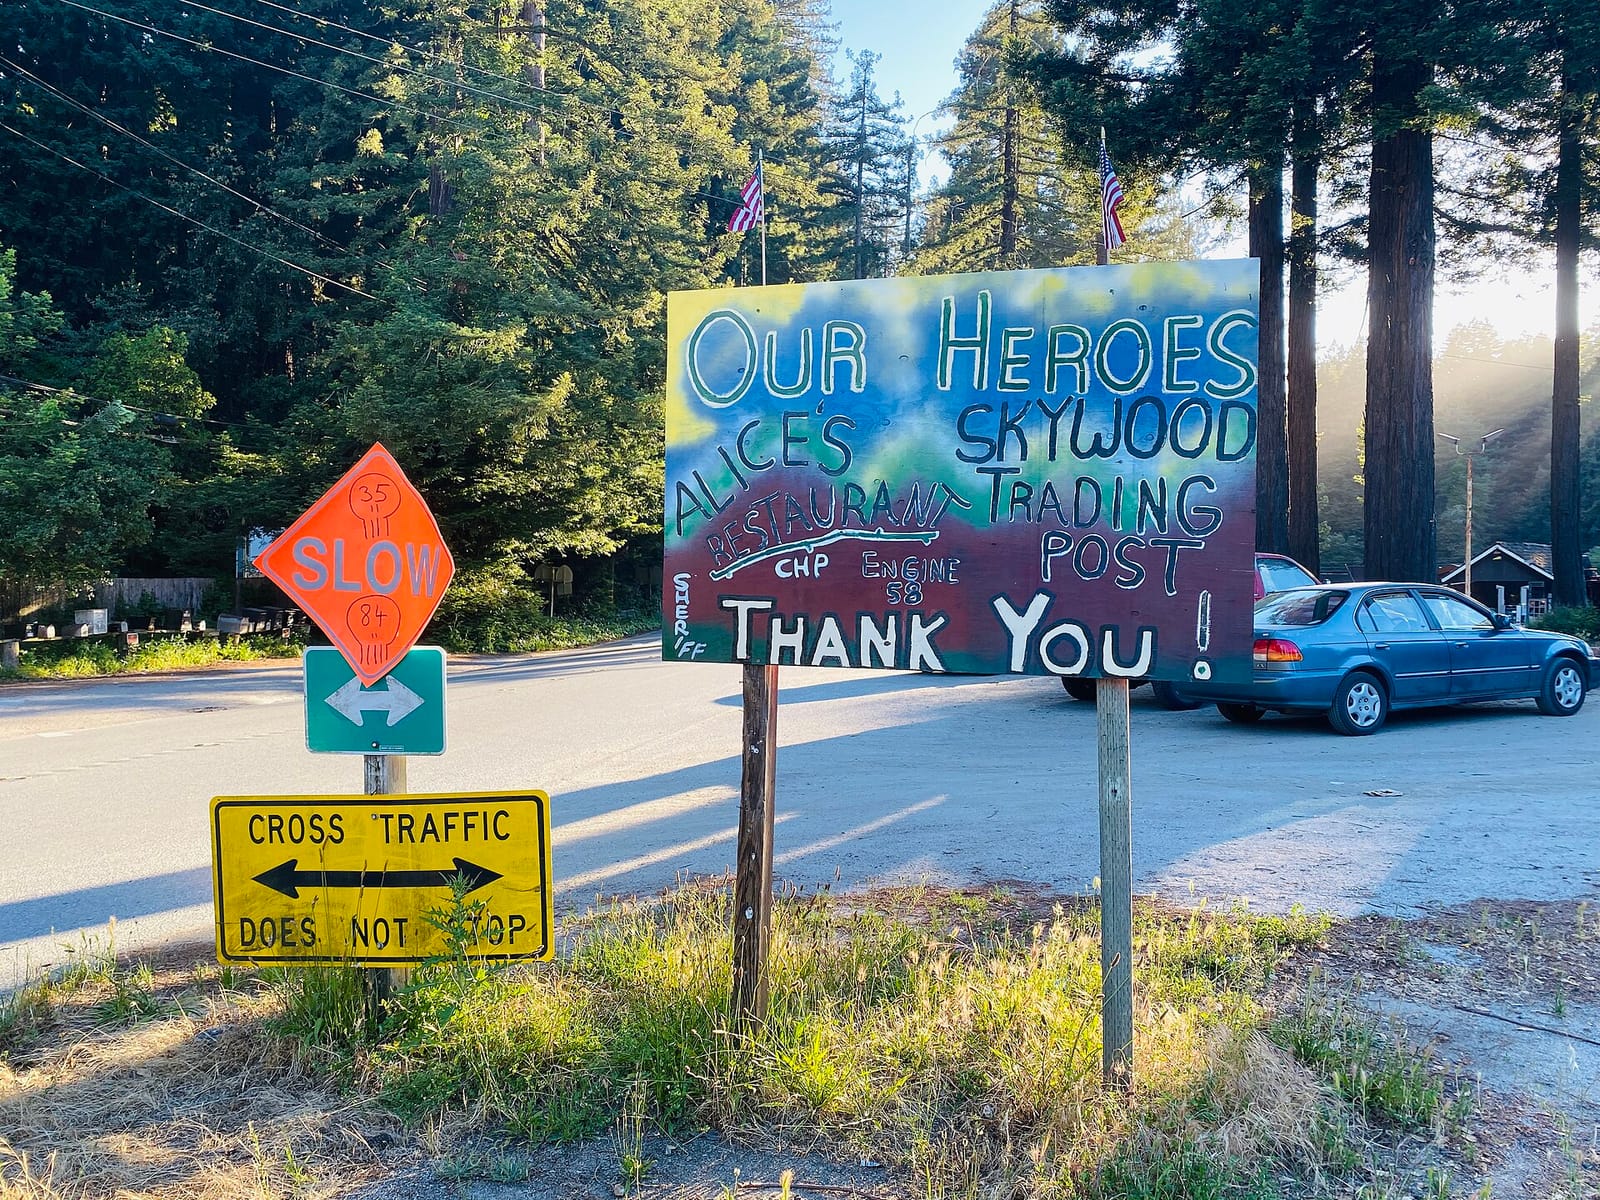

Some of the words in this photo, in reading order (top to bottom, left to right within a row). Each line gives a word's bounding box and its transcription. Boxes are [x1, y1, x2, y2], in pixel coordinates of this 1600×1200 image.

[687, 308, 866, 408] OUR
[937, 289, 1259, 399] HEROES
[956, 395, 1257, 464] SKYWOOD
[358, 484, 390, 503] 35
[675, 399, 856, 535] ALICE'S
[705, 479, 973, 567] RESTAURANT
[976, 467, 1224, 538] TRADING
[292, 536, 441, 599] SLOW
[774, 552, 830, 580] CHP
[861, 550, 961, 585] ENGINE
[886, 579, 924, 606] 58
[1041, 530, 1206, 597] POST
[359, 603, 388, 628] 84
[673, 572, 708, 660] SHERIFF
[719, 597, 947, 673] THANK
[248, 813, 346, 845] CROSS
[379, 810, 512, 844] TRAFFIC
[239, 917, 317, 948] DOES
[351, 916, 409, 949] NOT
